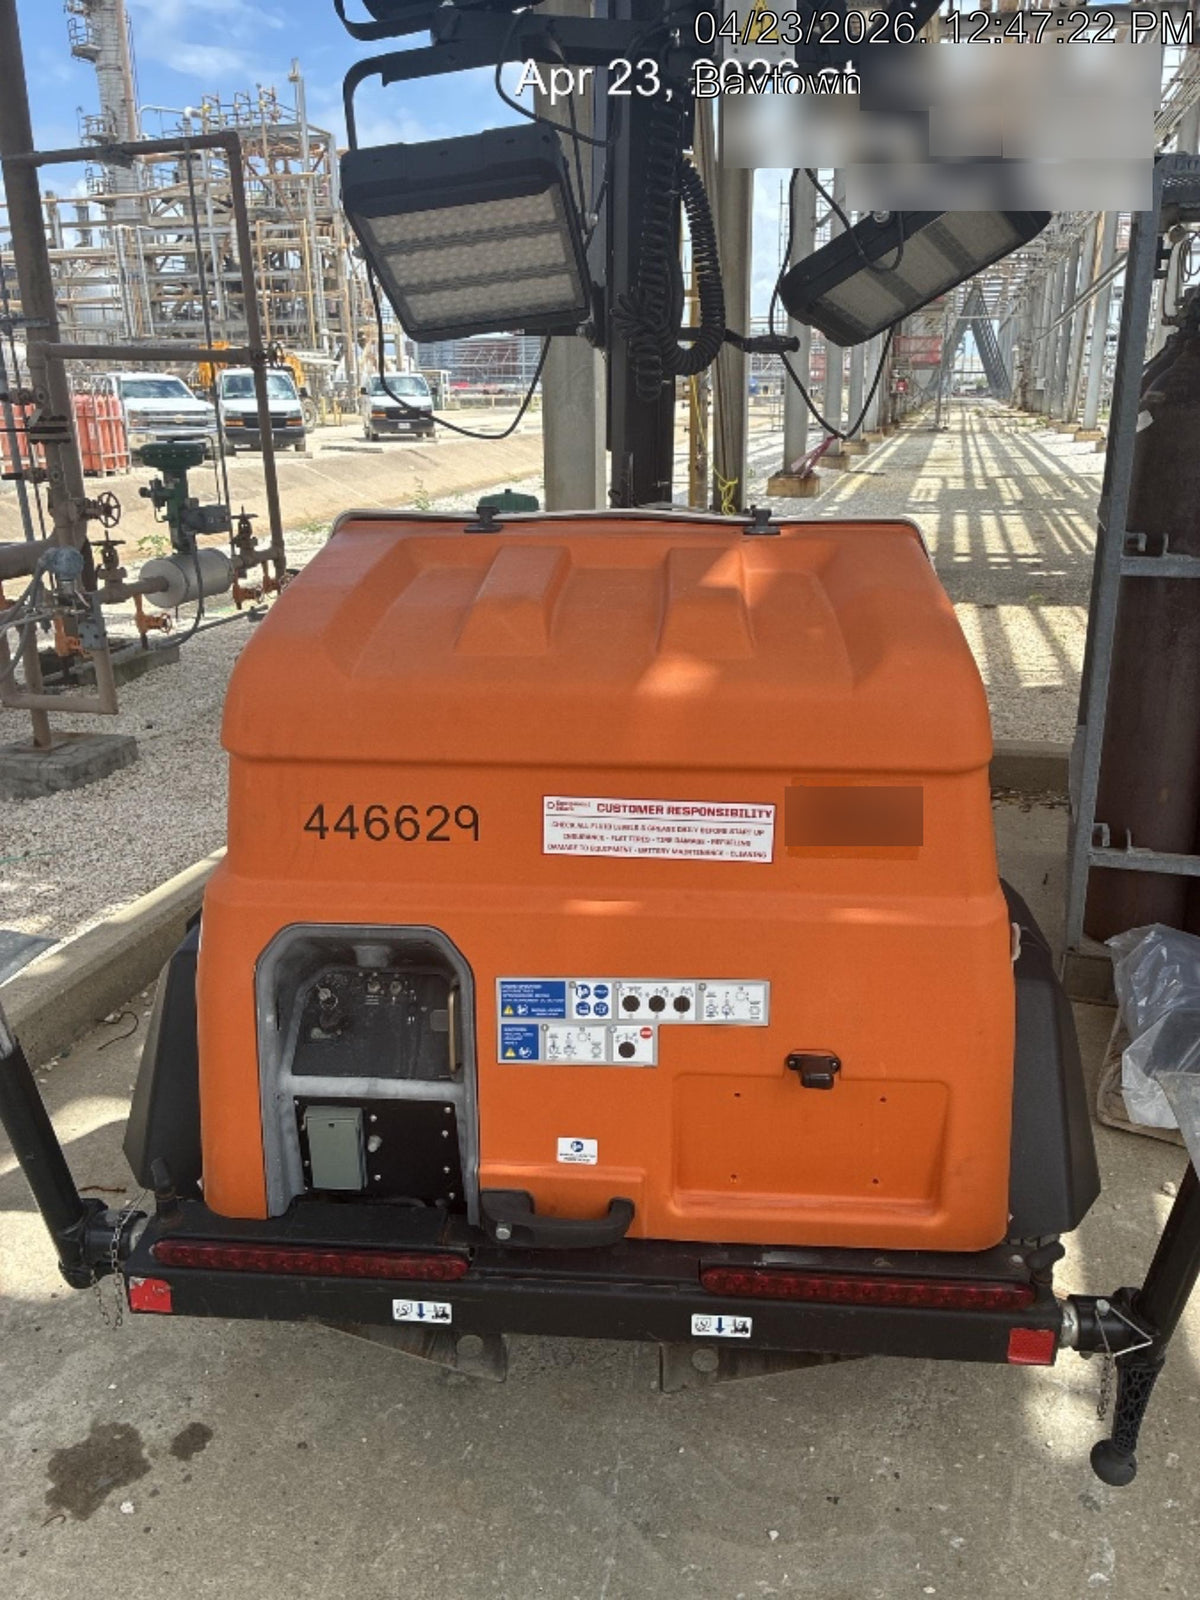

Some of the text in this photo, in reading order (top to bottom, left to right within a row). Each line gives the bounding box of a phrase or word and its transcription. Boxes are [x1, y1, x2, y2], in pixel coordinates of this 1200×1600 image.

[303, 803, 479, 842] 446629
[596, 802, 665, 815] CUSTOMER
[666, 805, 772, 818] RESPONSIBILITY
